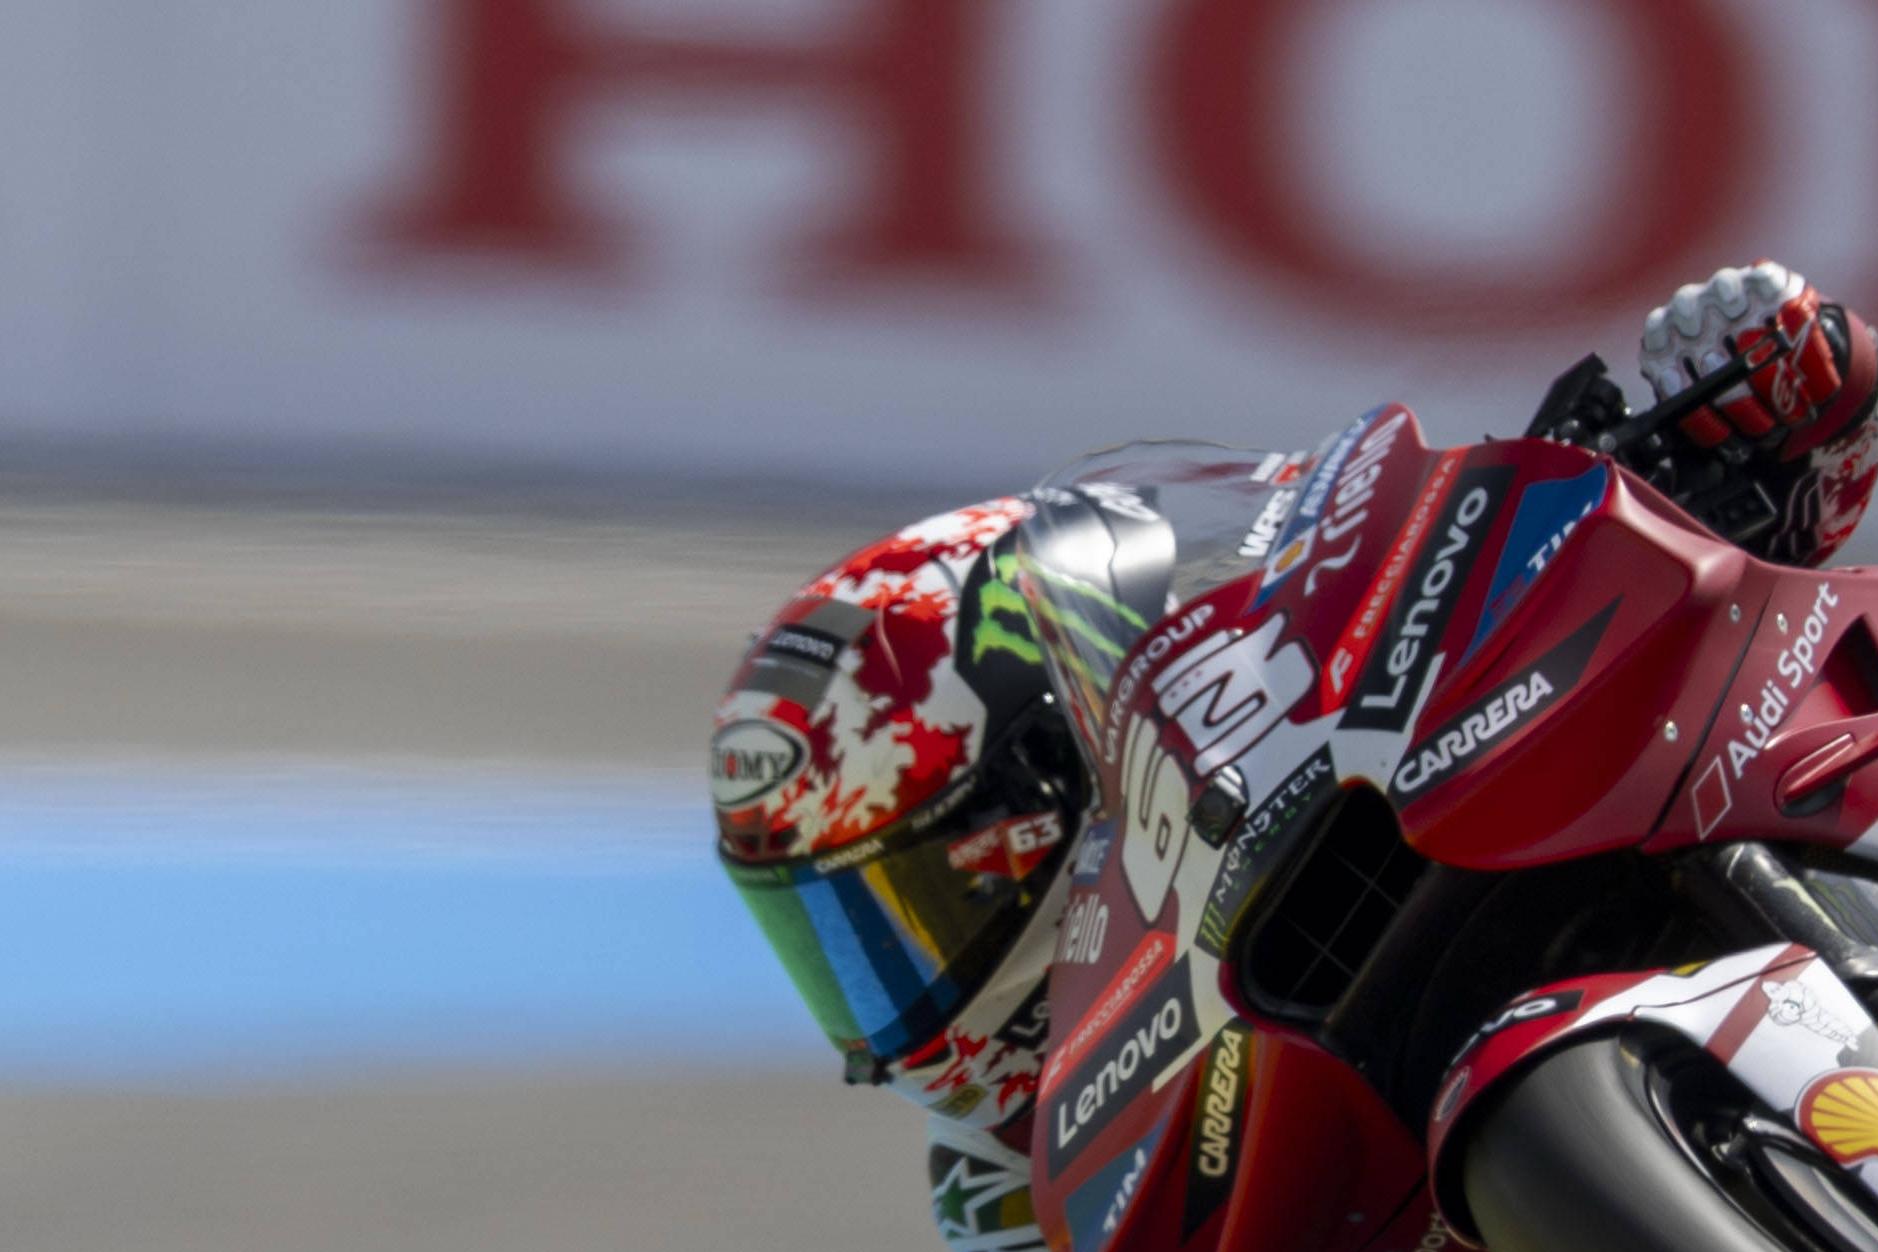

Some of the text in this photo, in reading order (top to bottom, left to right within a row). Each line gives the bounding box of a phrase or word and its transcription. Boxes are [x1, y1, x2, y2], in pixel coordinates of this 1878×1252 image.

[1361, 487, 1489, 709] Lenovo
[1395, 670, 1555, 793] CARRERA
[1726, 581, 1839, 780] Audi Sport
[1214, 757, 1332, 904] MONSTER
[1058, 997, 1182, 1149] Lenovo
[1199, 1028, 1244, 1176] CARRERA
[1102, 1147, 1147, 1233] TIM
